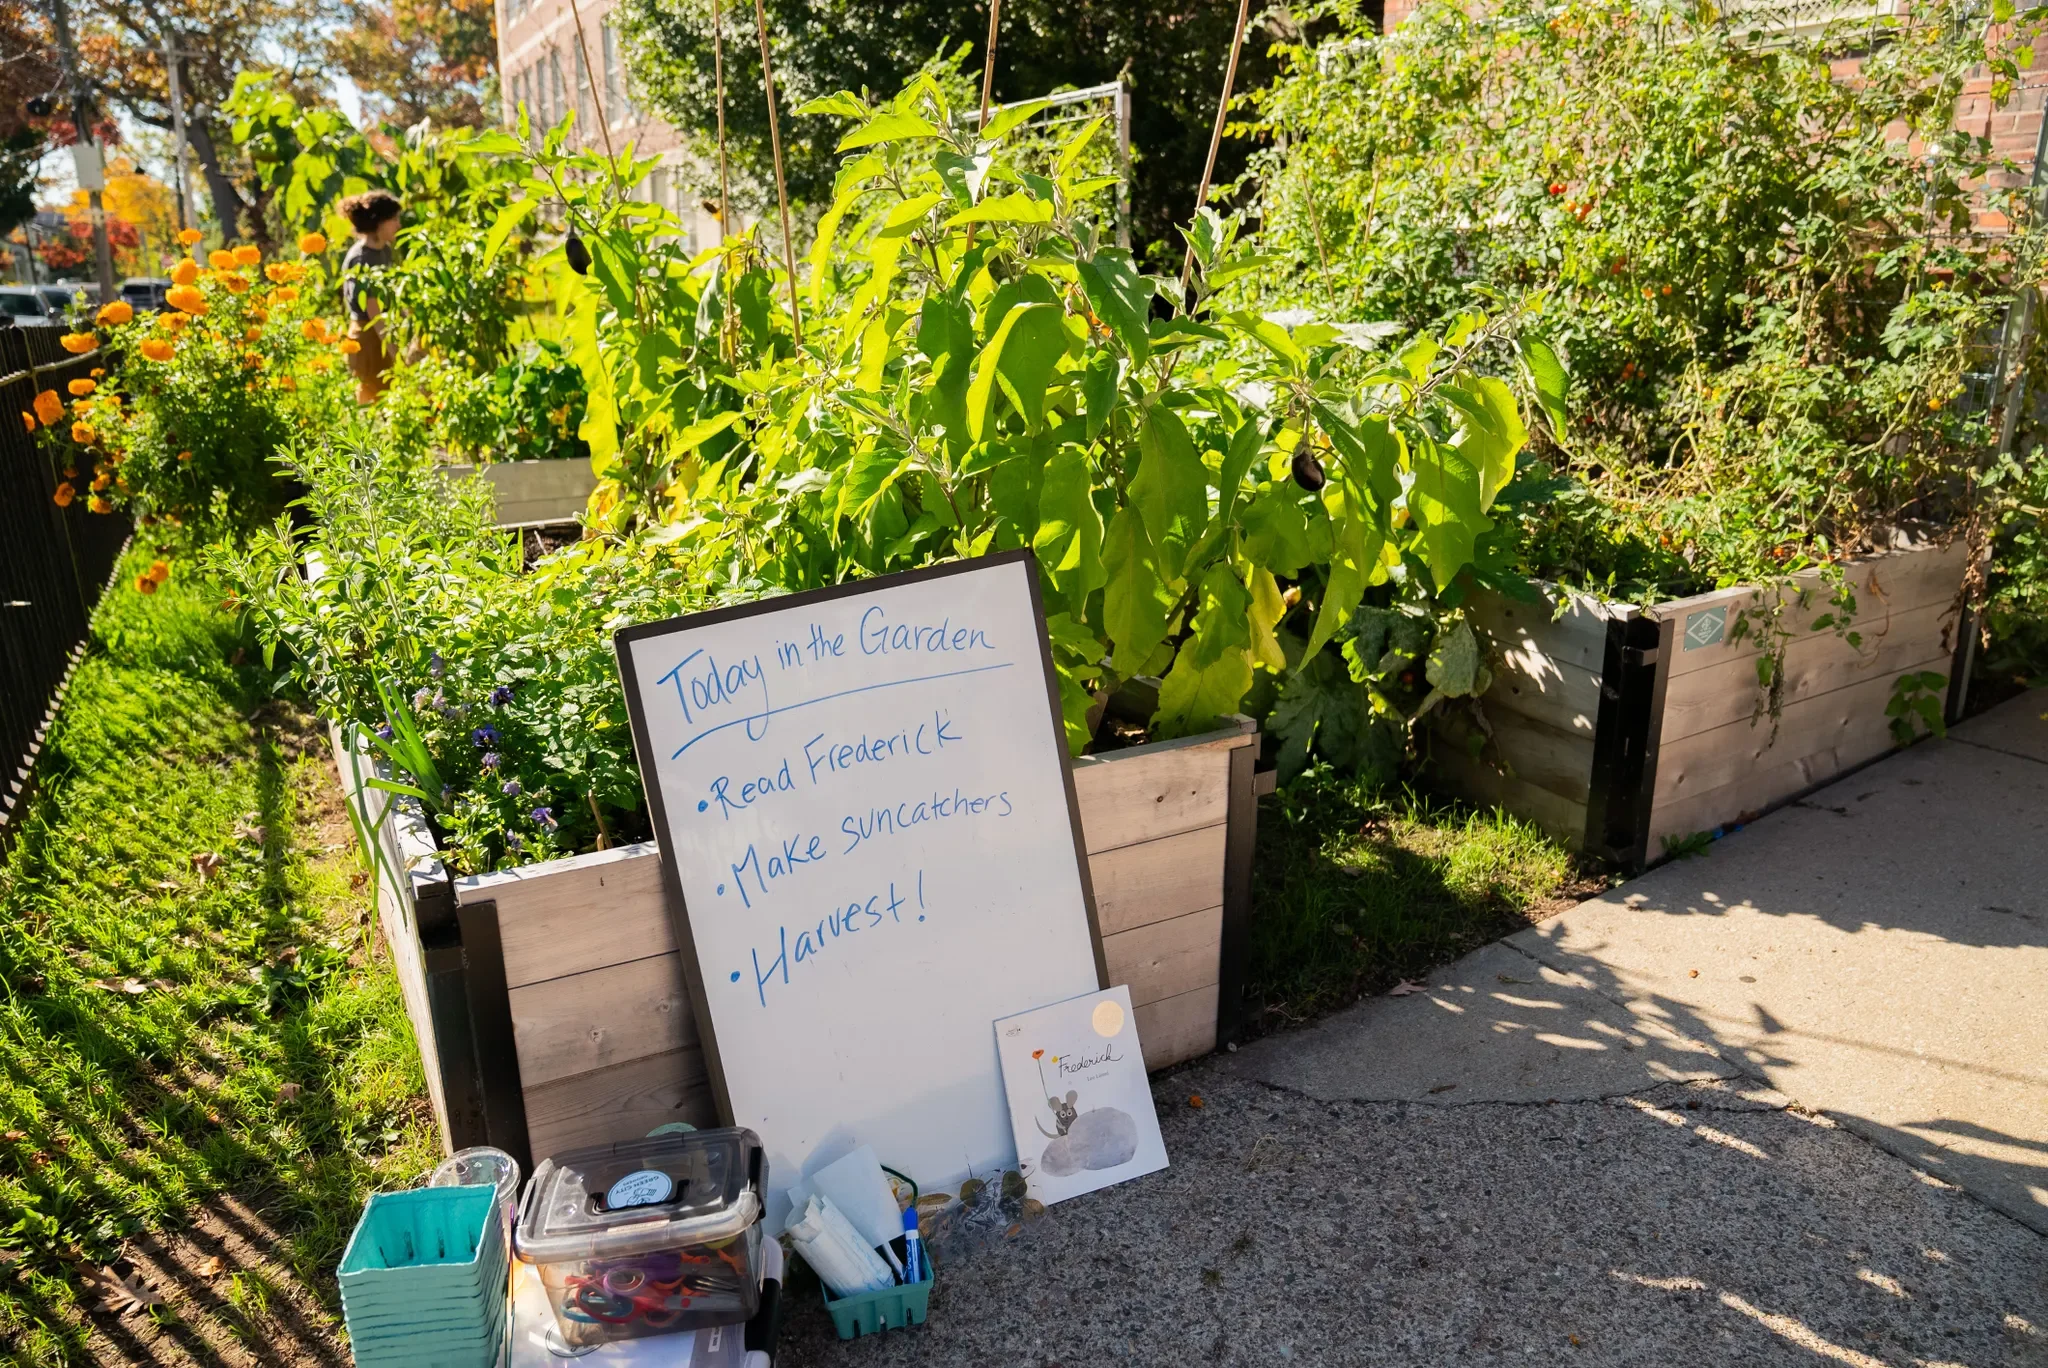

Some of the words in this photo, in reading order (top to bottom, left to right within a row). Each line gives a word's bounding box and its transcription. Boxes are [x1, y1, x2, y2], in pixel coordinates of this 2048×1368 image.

[656, 648, 770, 741] Today
[776, 640, 804, 670] in
[807, 623, 846, 661] the
[860, 606, 995, 656] Garden
[710, 758, 795, 820] Read
[803, 709, 963, 784] Frederick
[731, 833, 827, 909] Make
[841, 789, 1013, 855] suncatchers
[751, 870, 926, 1007] Harvest!
[1058, 1043, 1124, 1078] Frederick
[615, 1186, 633, 1195] CITY
[633, 1176, 659, 1187] GREEN
